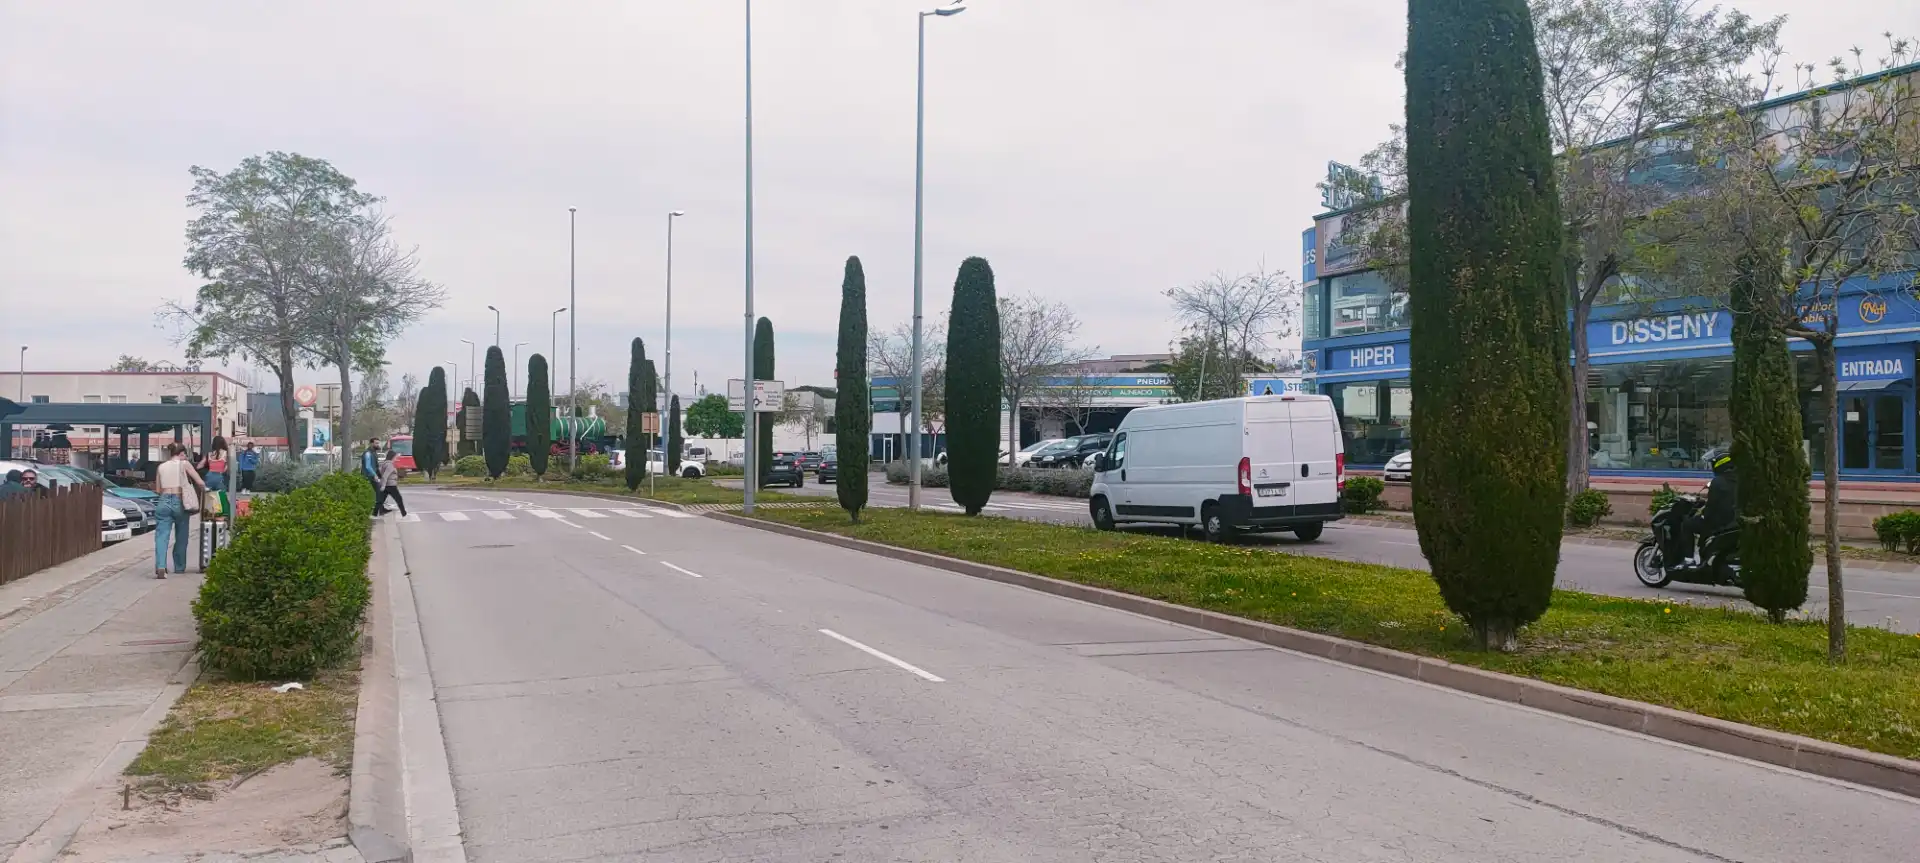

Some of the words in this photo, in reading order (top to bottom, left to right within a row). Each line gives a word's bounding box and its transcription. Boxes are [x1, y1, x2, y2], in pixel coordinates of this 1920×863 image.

[1611, 312, 1720, 345] DISSENY
[1349, 345, 1395, 369] HIPER
[1841, 358, 1904, 378] ENTRADA
